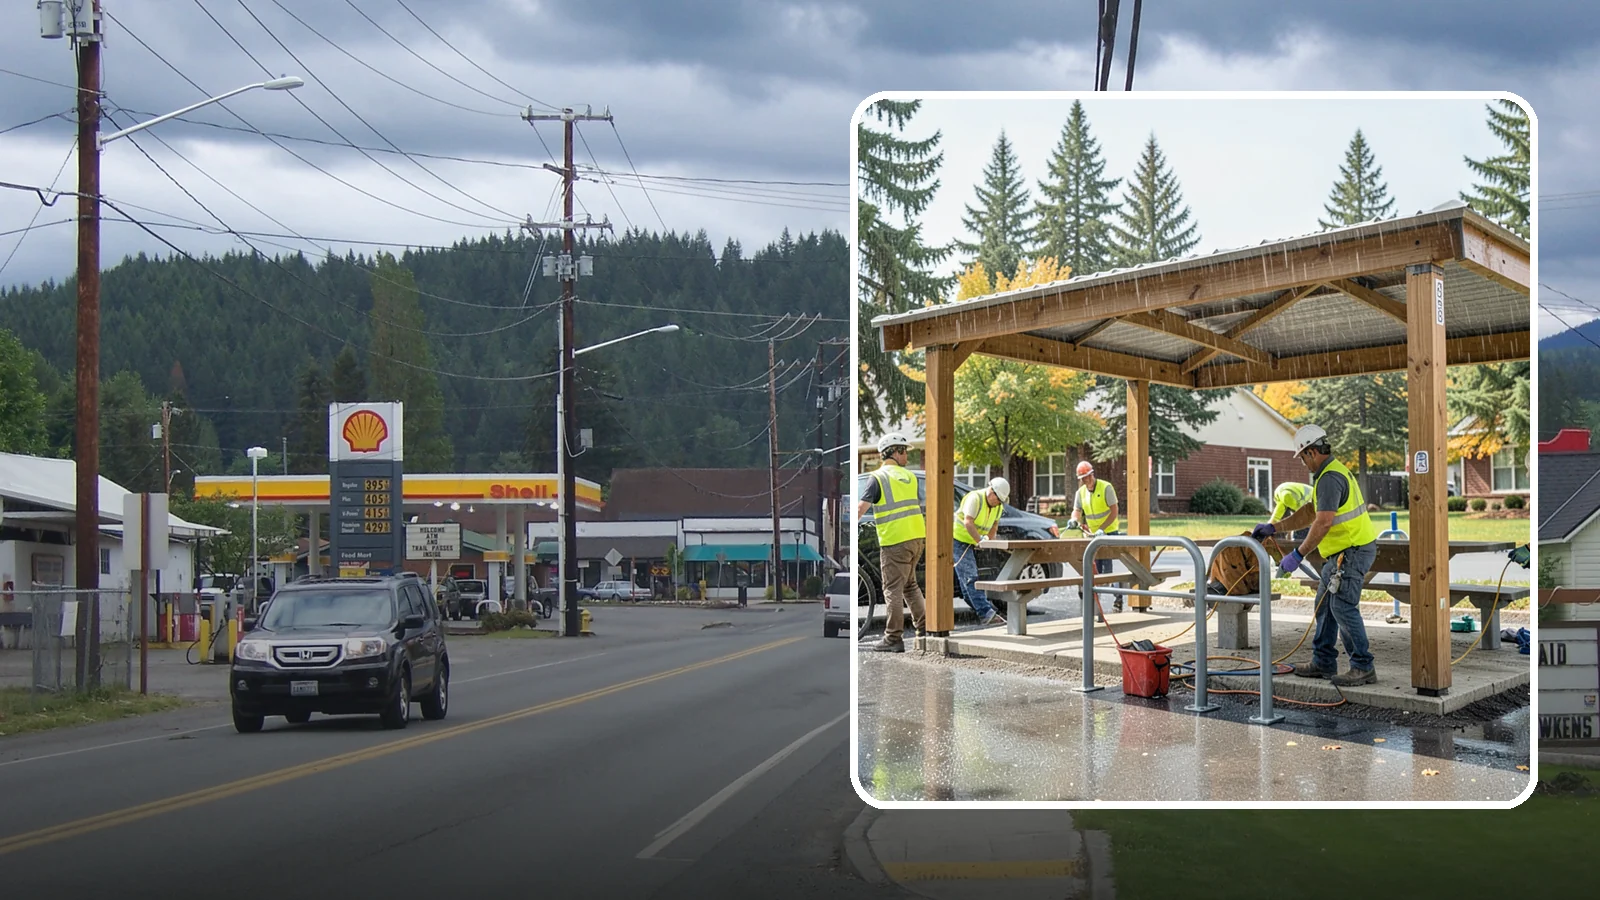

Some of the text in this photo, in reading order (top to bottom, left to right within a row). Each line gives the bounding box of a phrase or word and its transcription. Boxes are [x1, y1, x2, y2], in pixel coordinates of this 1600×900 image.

[366, 480, 383, 490] 395
[490, 484, 547, 499] Shell
[366, 494, 383, 504] 405
[366, 508, 383, 518] 415
[366, 522, 383, 532] 429
[1538, 643, 1567, 665] AID
[1538, 716, 1592, 739] WKENS
